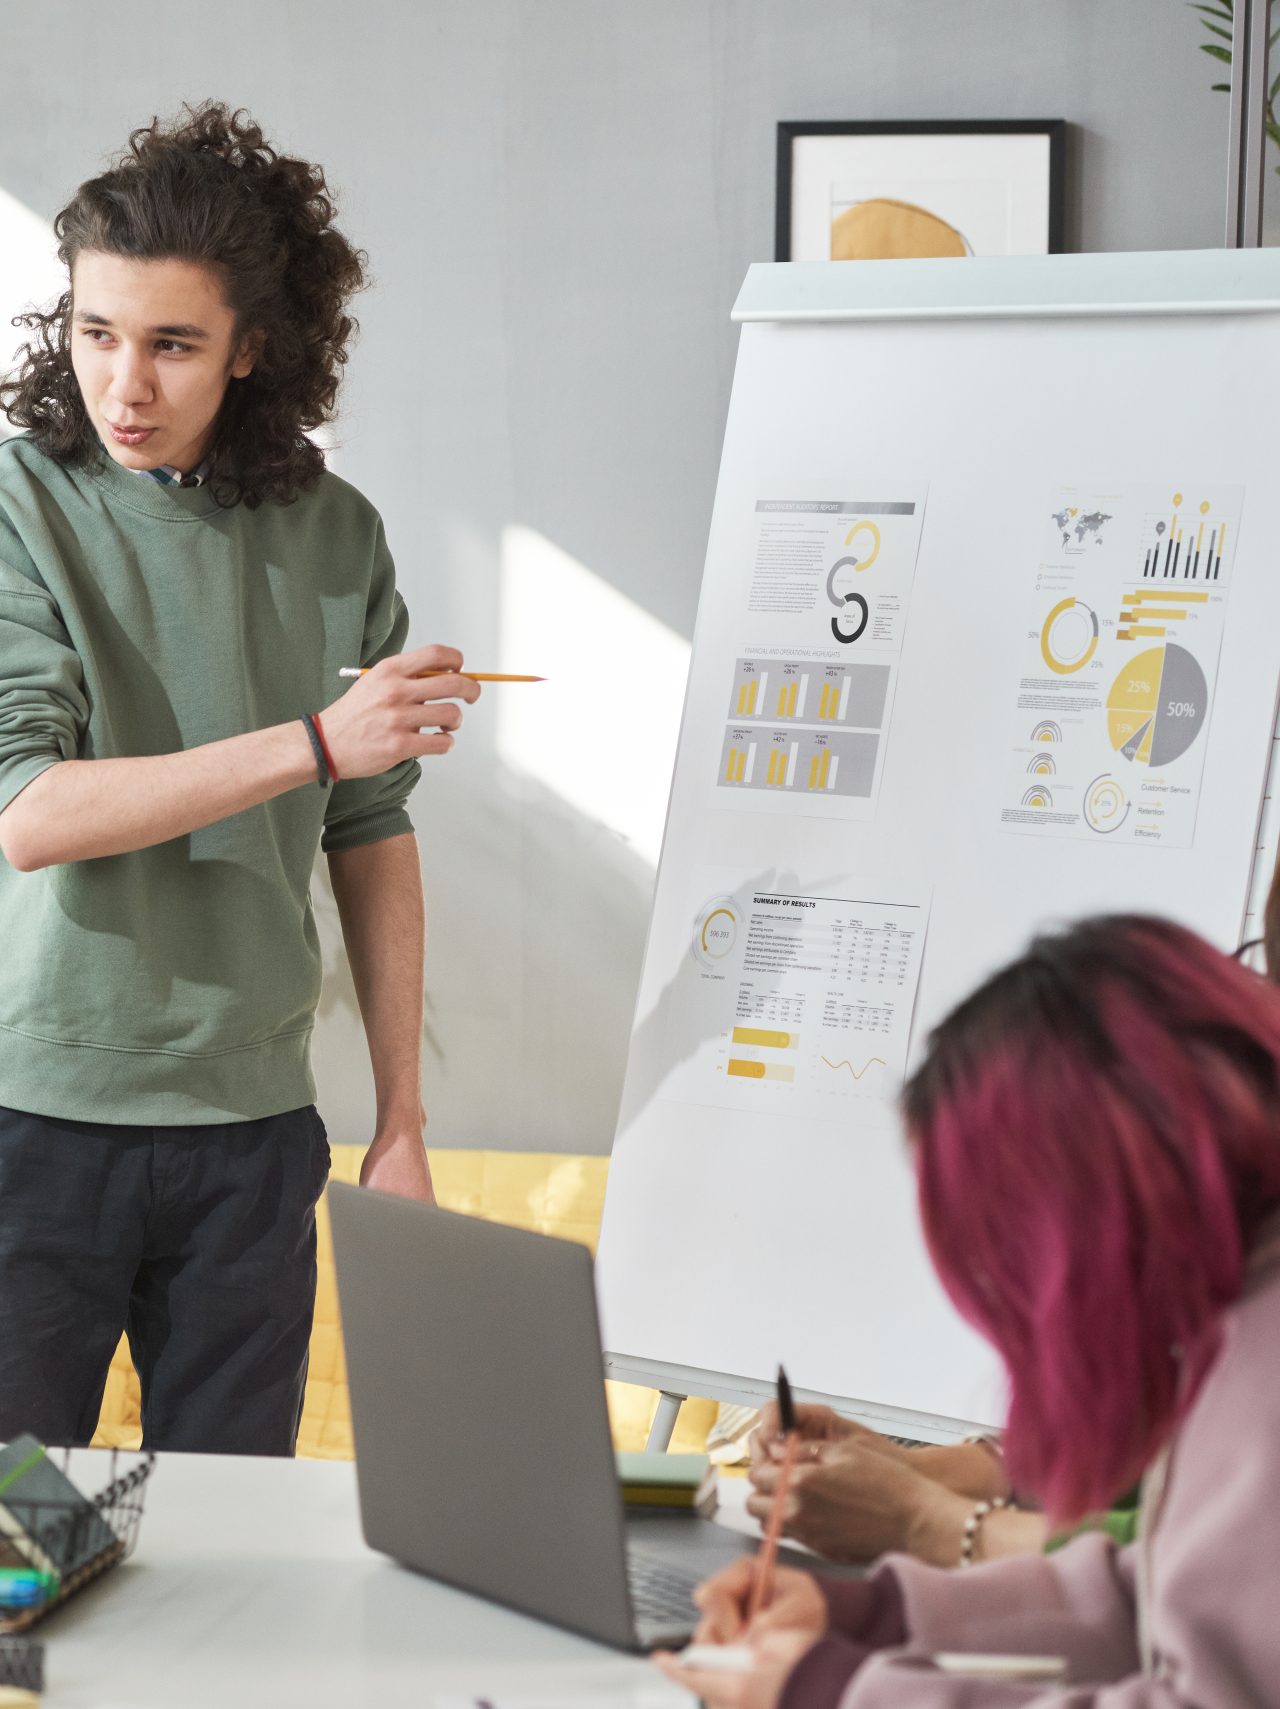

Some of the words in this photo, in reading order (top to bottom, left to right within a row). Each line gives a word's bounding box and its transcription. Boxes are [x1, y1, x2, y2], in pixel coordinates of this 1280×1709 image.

[1128, 680, 1151, 694] 25%
[1166, 702, 1196, 718] 50%
[1141, 784, 1169, 792] Customer
[1170, 786, 1191, 794] Service
[1138, 807, 1165, 816] Retention
[753, 897, 782, 906] SUMMARY
[791, 900, 816, 908] RESULTS
